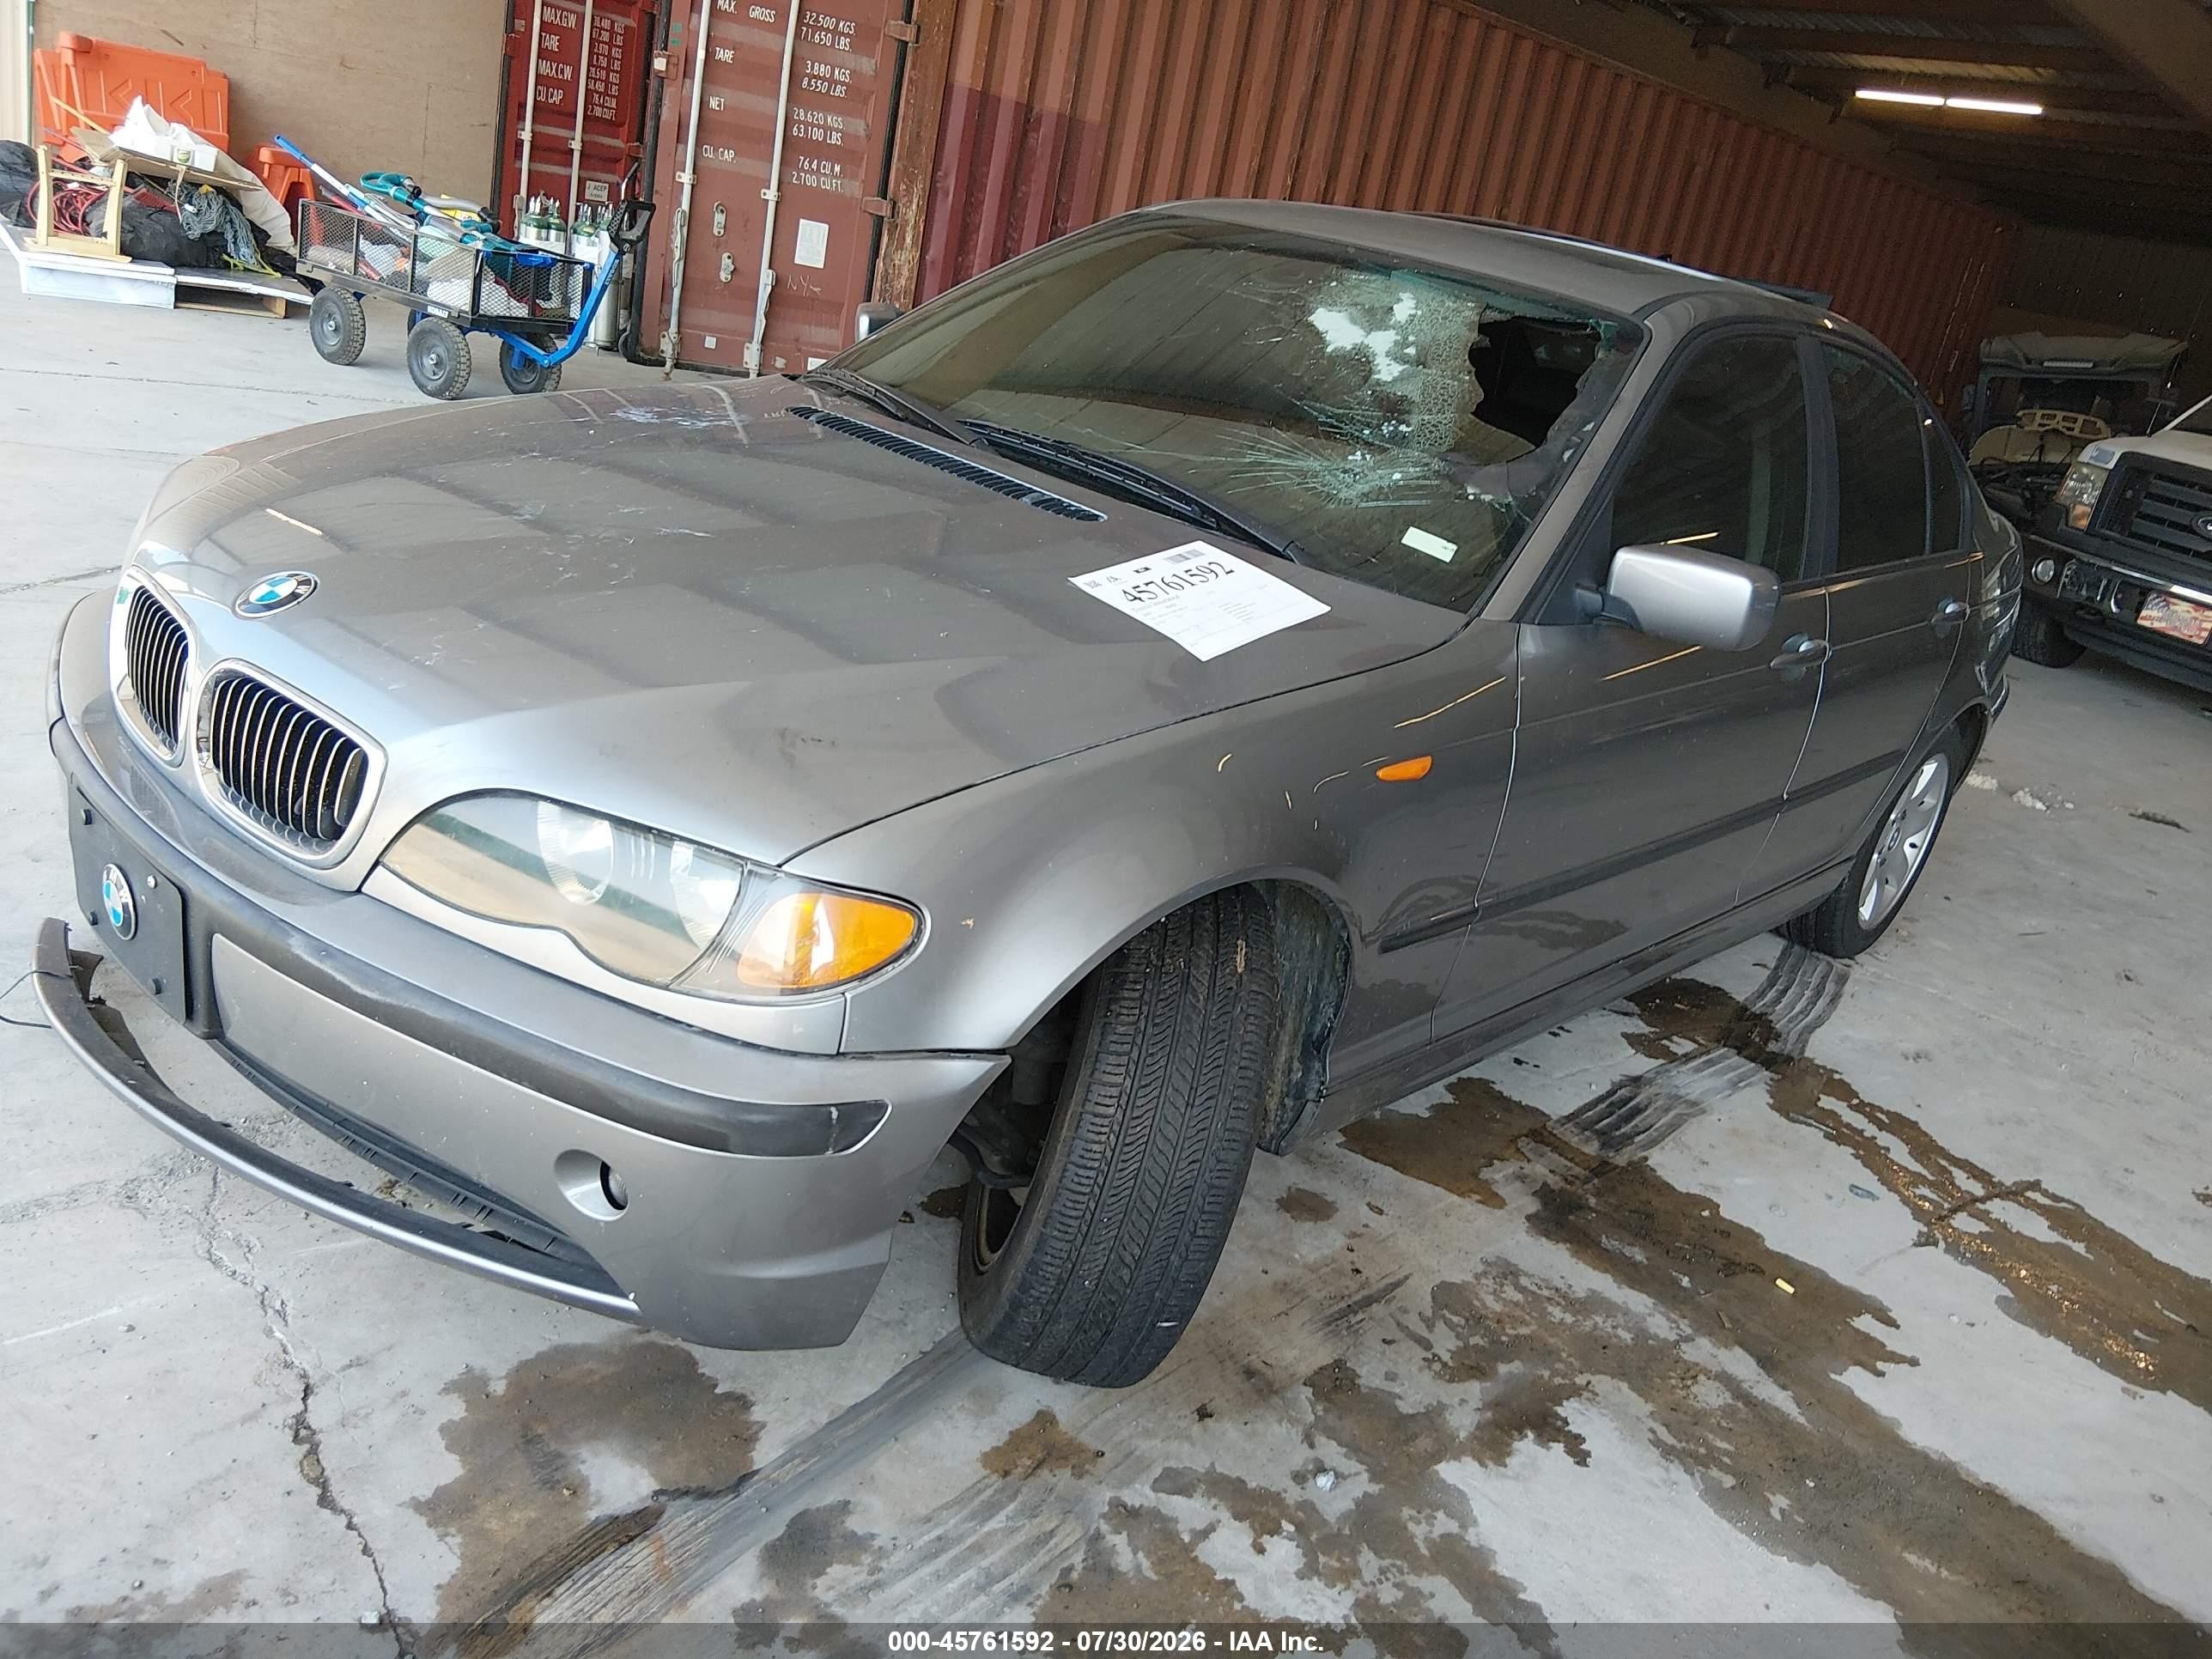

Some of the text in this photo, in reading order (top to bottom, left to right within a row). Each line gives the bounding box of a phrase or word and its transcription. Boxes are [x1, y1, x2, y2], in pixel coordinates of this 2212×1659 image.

[717, 0, 776, 23] MAX. GROSS
[803, 11, 856, 36] 32.500 KGS.
[541, 32, 560, 52] TARE
[800, 27, 852, 52] 71.650 LBS.
[714, 47, 735, 64] TARE
[805, 60, 852, 84] 3.880 KGS.
[801, 77, 848, 98] 8.550 LBS.
[709, 96, 725, 112] NET
[793, 107, 846, 131] 28.620 KGS.
[792, 124, 844, 147] 63.100 LBS.
[702, 144, 737, 163] CU. CAP.
[799, 156, 843, 177] 76.4 CU.M.
[792, 172, 843, 192] 2.700 CU.FT.
[1121, 562, 1235, 603] 45761592
